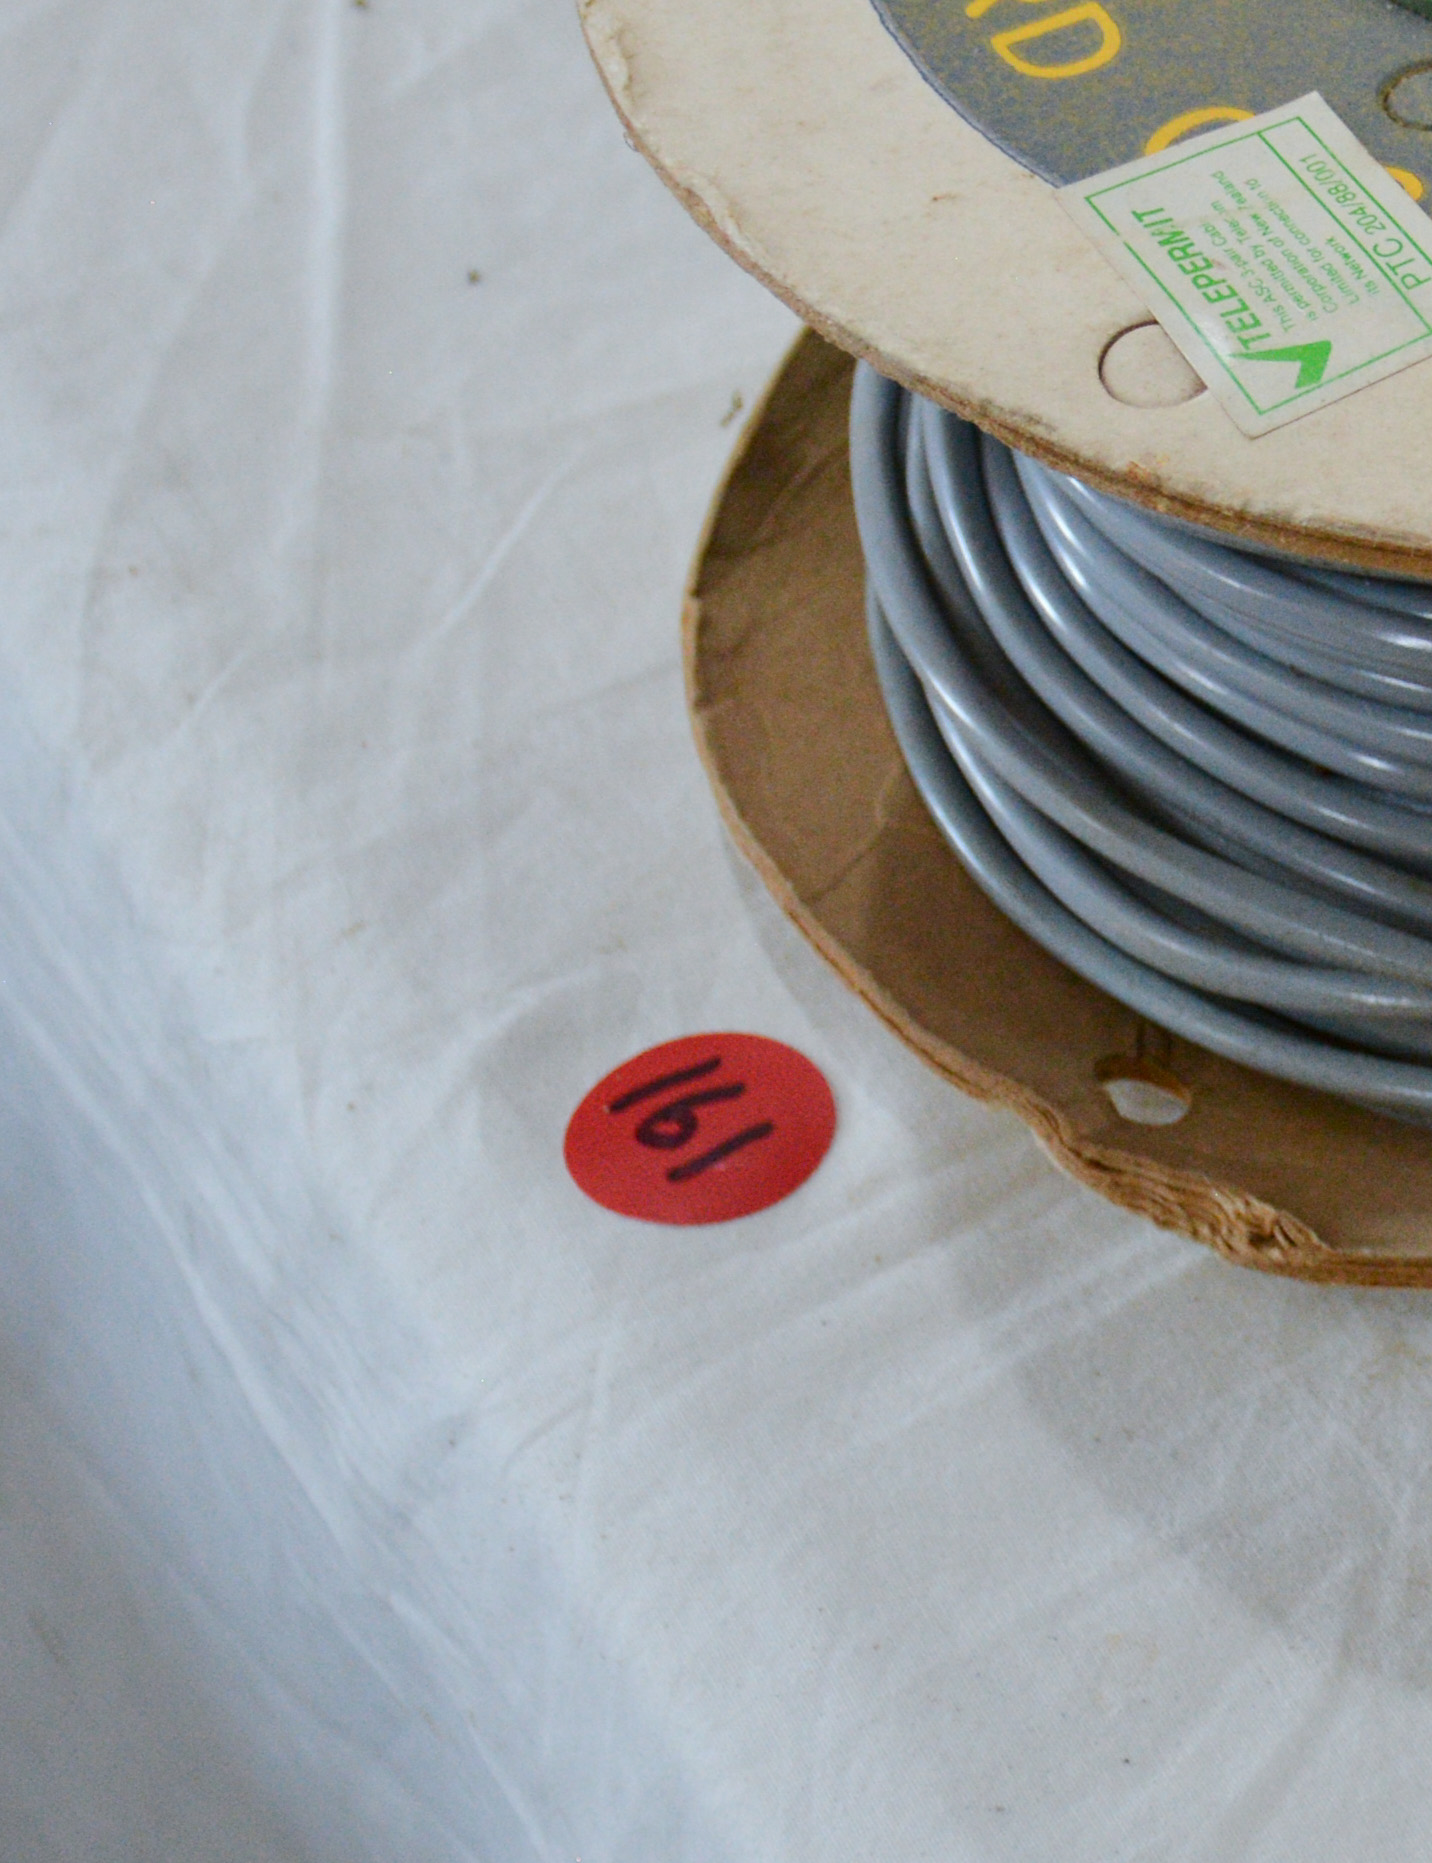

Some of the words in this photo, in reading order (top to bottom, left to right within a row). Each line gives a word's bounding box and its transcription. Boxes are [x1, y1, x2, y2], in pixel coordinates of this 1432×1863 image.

[1243, 175, 1263, 191] to
[1299, 150, 1387, 236] 204/88/001
[1246, 209, 1275, 236] New
[1247, 243, 1266, 261] by
[1266, 233, 1286, 247] of
[1220, 245, 1255, 279] 3-pair
[1302, 245, 1325, 264] for
[1323, 235, 1368, 281] Network
[1371, 233, 1432, 292] PTC
[1131, 203, 1272, 351] TELEPERMIT
[1246, 276, 1278, 304] ASC
[1257, 257, 1313, 312] permitted
[1279, 245, 1340, 313] Corporation
[1316, 260, 1360, 305] Limited
[1360, 280, 1381, 296] its
[1268, 303, 1297, 331] This
[1303, 310, 1318, 322] is
